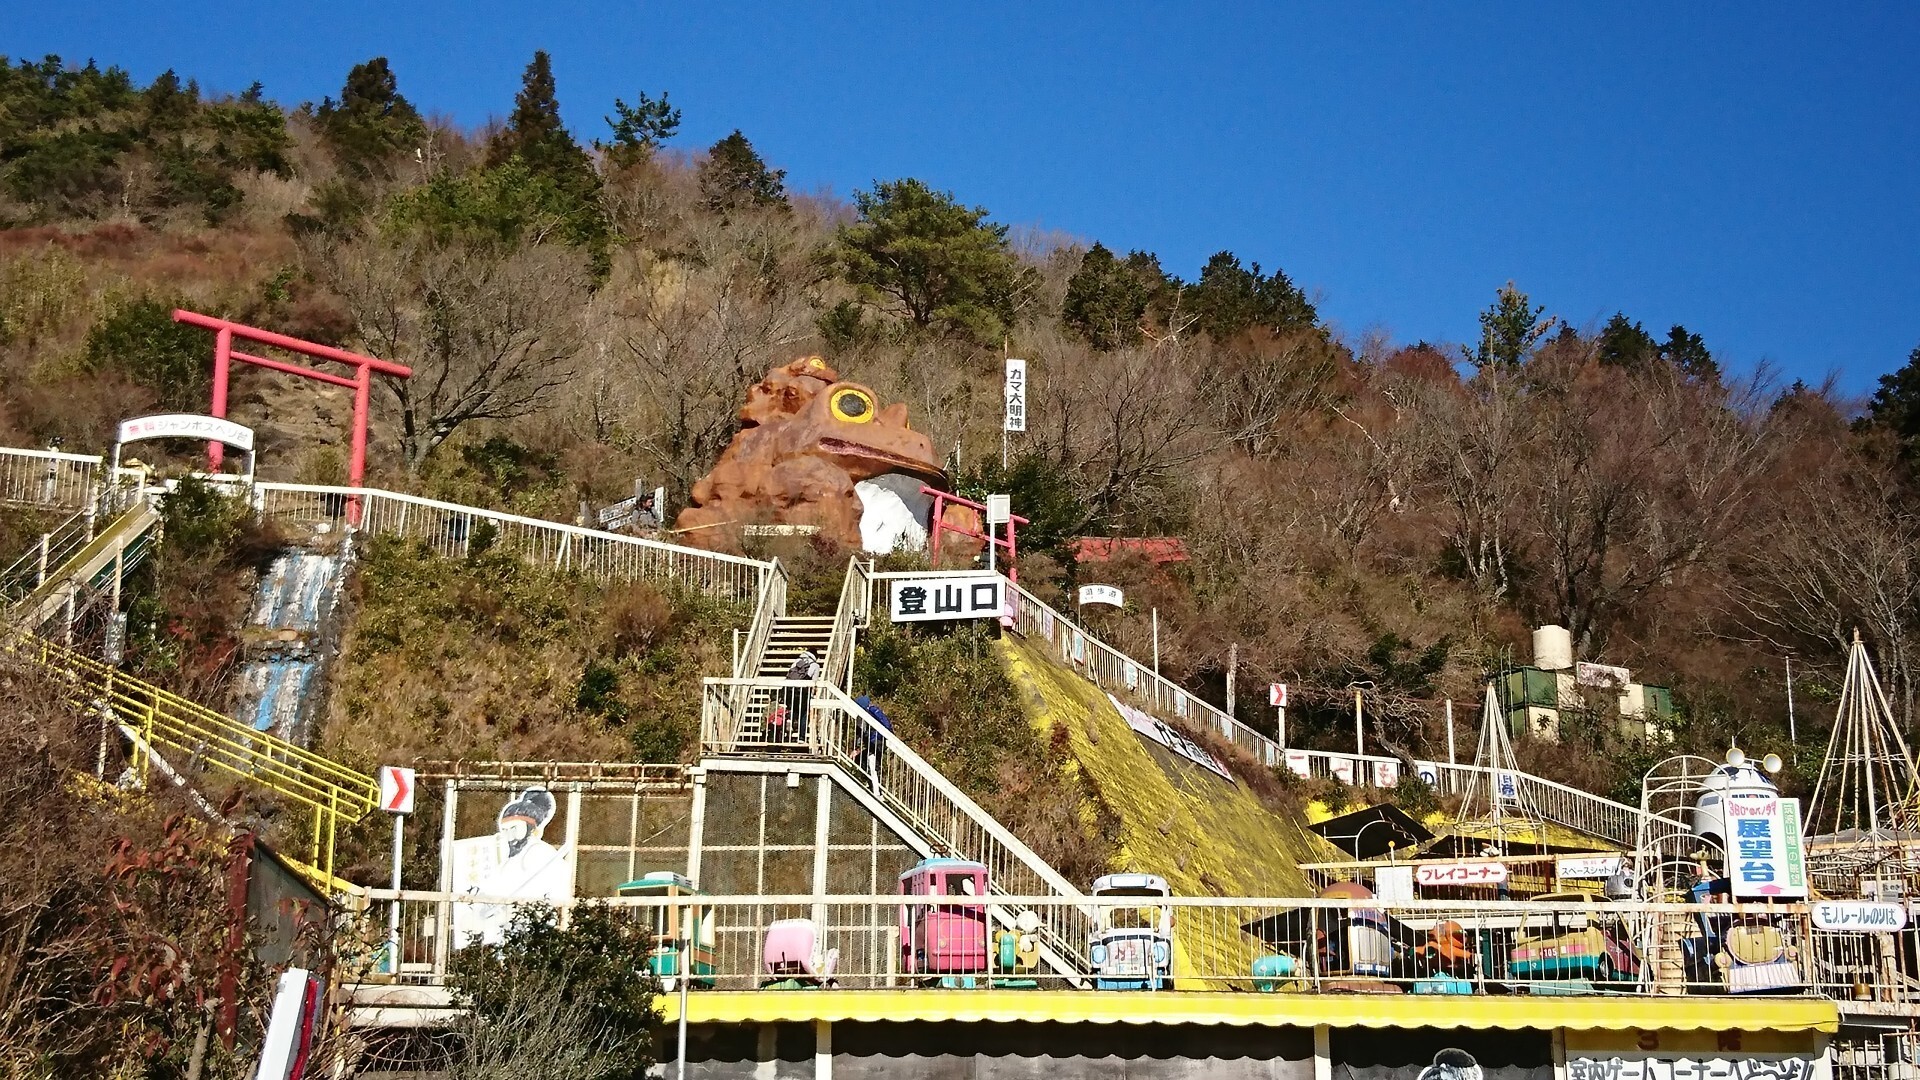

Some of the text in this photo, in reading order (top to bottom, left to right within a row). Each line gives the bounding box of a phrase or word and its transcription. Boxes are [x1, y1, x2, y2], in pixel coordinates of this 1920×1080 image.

[898, 583, 998, 615] 登山口
[1737, 818, 1775, 882] 展望台
[1421, 866, 1501, 881] プレイコーナー
